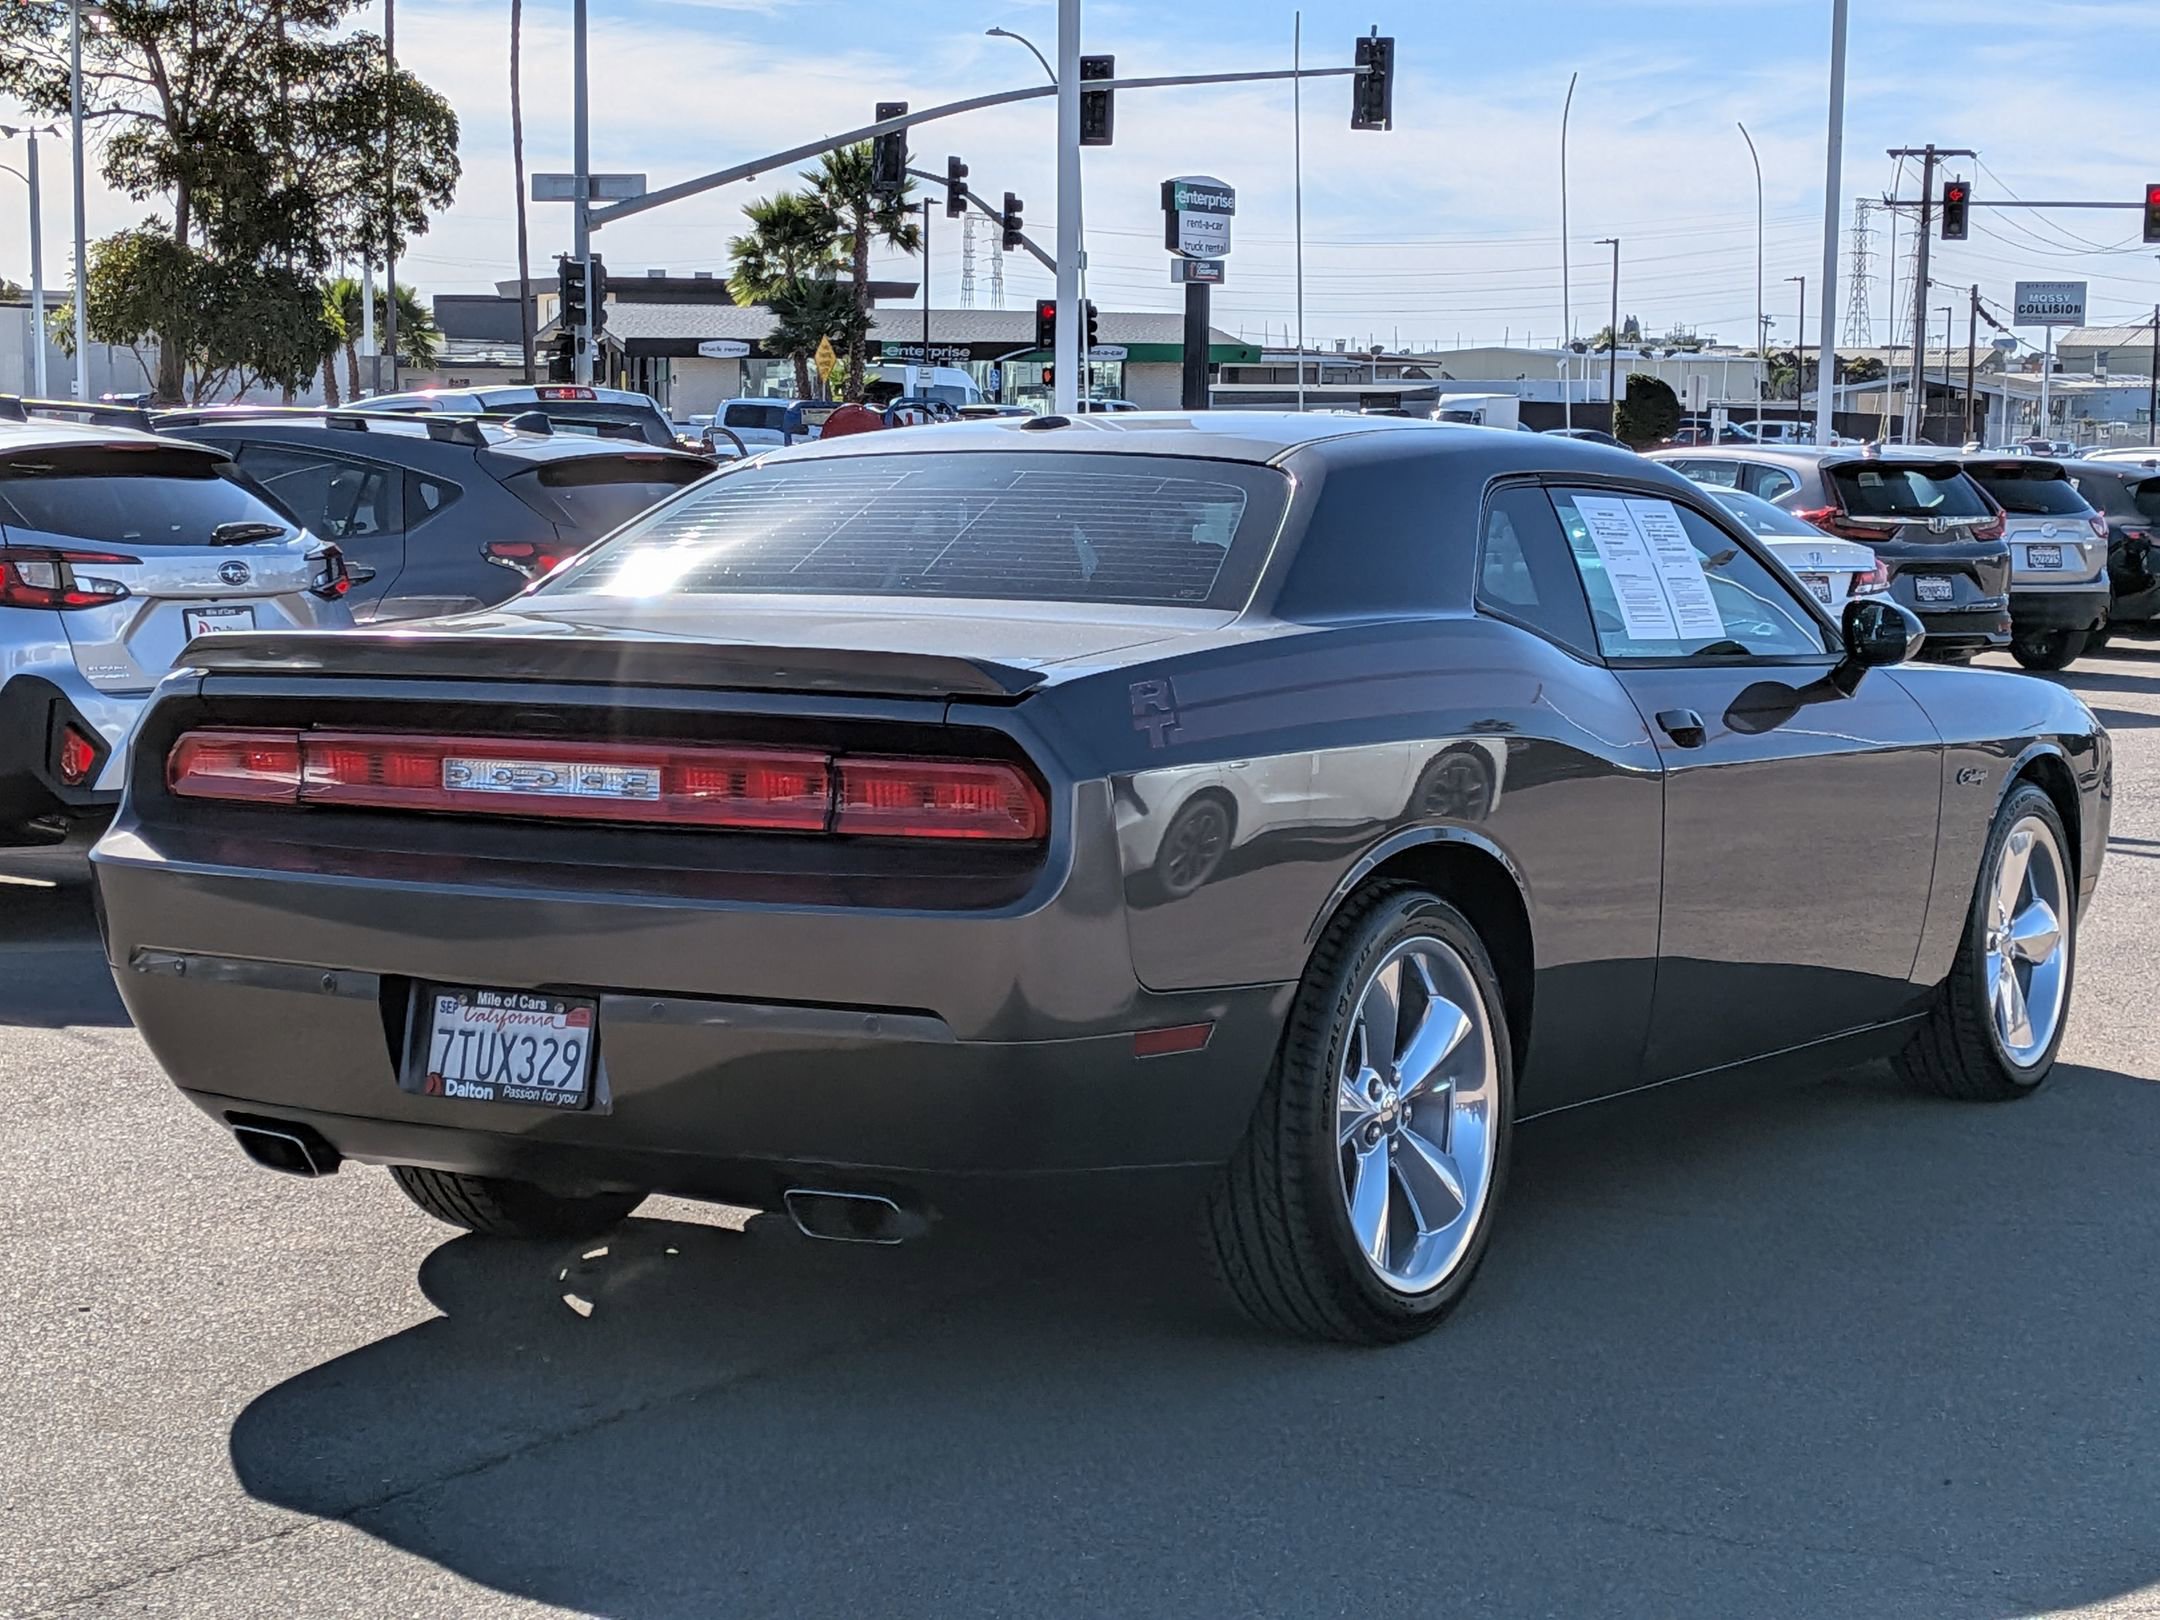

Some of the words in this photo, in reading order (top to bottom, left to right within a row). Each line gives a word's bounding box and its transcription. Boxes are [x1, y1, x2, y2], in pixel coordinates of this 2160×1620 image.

[1177, 190, 1234, 210] enterprise
[1186, 219, 1223, 231] rent-a-car
[1184, 240, 1203, 252] truck
[1205, 243, 1226, 253] rental
[2029, 294, 2071, 302] MOSSY
[2018, 304, 2081, 314] COLLISION
[477, 991, 501, 1006] Mile
[503, 994, 518, 1008] of
[520, 995, 547, 1011] Cars
[440, 1000, 459, 1014] SEP
[464, 1006, 566, 1032] California
[437, 1028, 581, 1088] 7TUX329
[445, 1079, 494, 1100] Dalton
[502, 1085, 540, 1101] Passion
[541, 1088, 557, 1102] for
[559, 1092, 578, 1105] you
